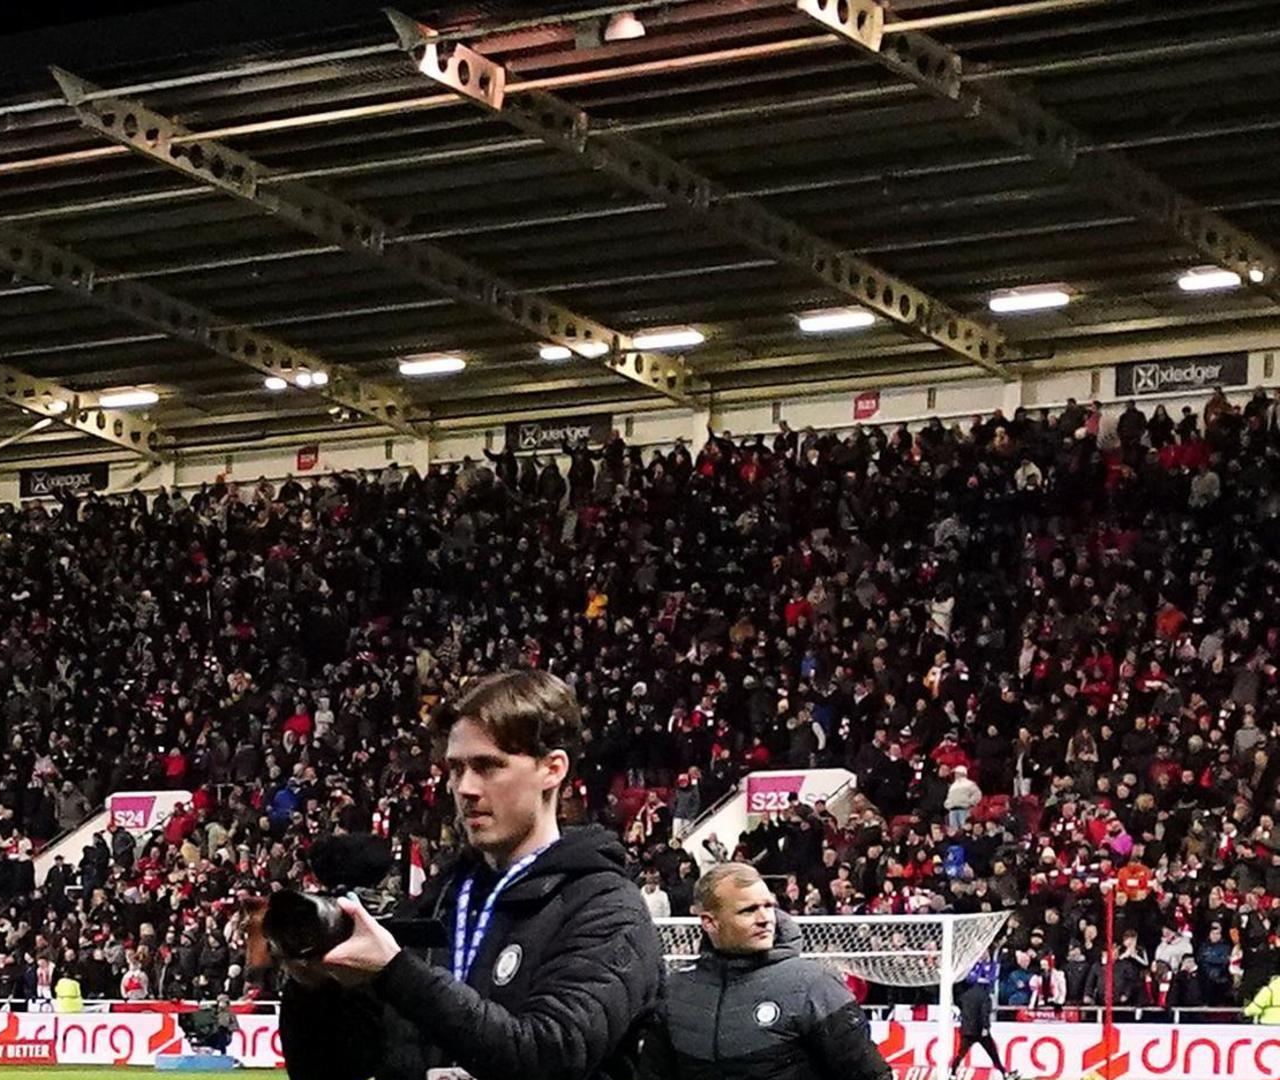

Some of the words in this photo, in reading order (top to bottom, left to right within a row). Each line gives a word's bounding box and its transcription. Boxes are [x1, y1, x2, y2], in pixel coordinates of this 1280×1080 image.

[751, 791, 791, 811] S23
[114, 809, 145, 827] S24
[7, 1044, 50, 1058] BETTER
